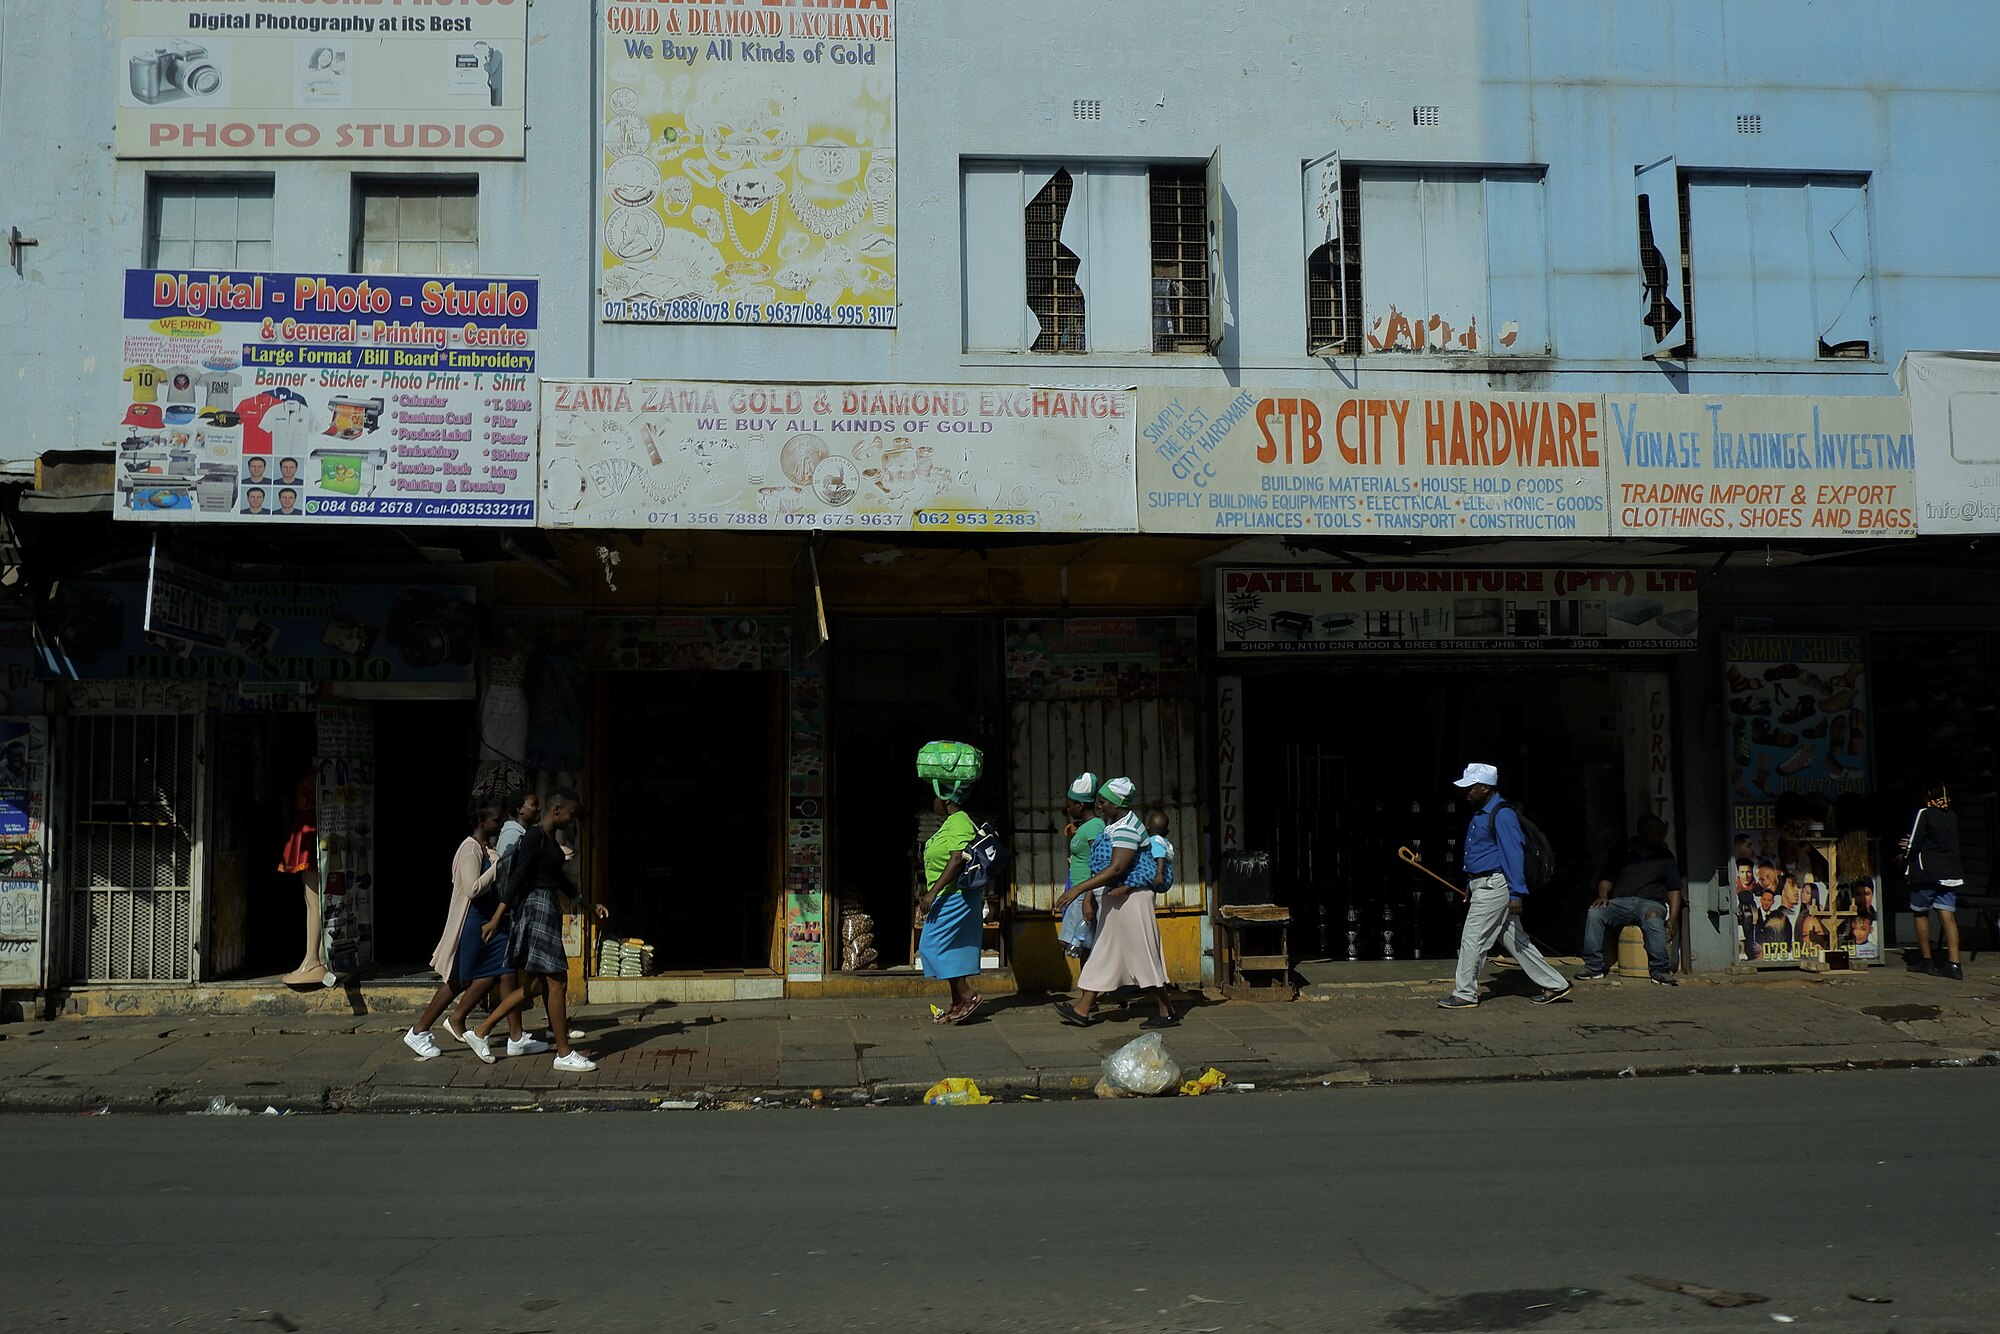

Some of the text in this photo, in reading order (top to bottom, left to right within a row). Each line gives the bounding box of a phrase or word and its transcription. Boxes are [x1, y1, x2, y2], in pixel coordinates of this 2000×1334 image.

[189, 13, 471, 32] Digital Photography at its Best
[606, 6, 782, 38] GOLD & DIAMOND
[623, 39, 875, 66] We Buy All Kinds of Gold
[149, 123, 505, 149] PHOTO STUDIO
[153, 273, 528, 317] Digital Photo Studio
[605, 300, 894, 325] 071 356 7888/078 675 9637/084 995 3117
[160, 320, 213, 330] WE PRINT
[260, 317, 527, 351] & General Printing Centre
[251, 346, 293, 366] Large
[299, 347, 352, 364] Format
[138, 373, 153, 386] 10
[255, 367, 307, 386] Banner
[319, 369, 369, 388] Sticker
[381, 371, 422, 389] Photo
[426, 372, 460, 390] Print
[492, 373, 526, 391] Shirt
[399, 393, 448, 407] Calendar
[554, 385, 1126, 419] ZAMA ZAMA GOLD & DIAMOND EXCHANGE
[398, 411, 472, 425] Business Card
[697, 418, 993, 433] WE BUY ALL KINDS OF GOLD
[1143, 397, 1186, 444] SIMPLY
[398, 427, 472, 441] Product Label
[491, 432, 528, 445] Poster
[1155, 405, 1208, 462] THE BEST
[1171, 389, 1257, 480] CITY HARDWARE
[1255, 398, 1600, 468] STB CITY HARDWARE
[398, 444, 459, 460] Embroidery
[490, 465, 517, 480] Mug
[460, 480, 505, 494] Drawing
[1261, 476, 1324, 491] BUILDING
[1329, 476, 1410, 492] MATERIALS
[1421, 477, 1467, 493] HOUSE
[1473, 478, 1511, 493] HOLD
[1621, 483, 1897, 505] TRADING IMPORT & EXPORT
[320, 500, 346, 512] 084
[350, 501, 376, 513] 684
[380, 502, 413, 513] 2678
[1148, 492, 1603, 511] SUPPLY BUILDING EQUIPMENTS ELECTRICAL GOODS
[647, 512, 1036, 526] 071 356 7888 078 675 9637 062 953 2383
[1215, 512, 1576, 530] APPLIANCES TOOLS TRANSPORT CONSTRUCTION
[1738, 508, 1803, 528] SHOES
[1811, 508, 1851, 528] AND
[1857, 508, 1918, 529] BAGS.
[1226, 570, 1697, 597] PATEL K FURNITURE (PTY) LTD
[1241, 642, 1274, 650] SHOP
[1358, 641, 1390, 649] MOOI
[1392, 641, 1401, 649] &
[1405, 641, 1438, 649] BREE
[1728, 637, 1861, 662] SAMMY SHOES
[126, 655, 393, 681] PHOTO STUDIO
